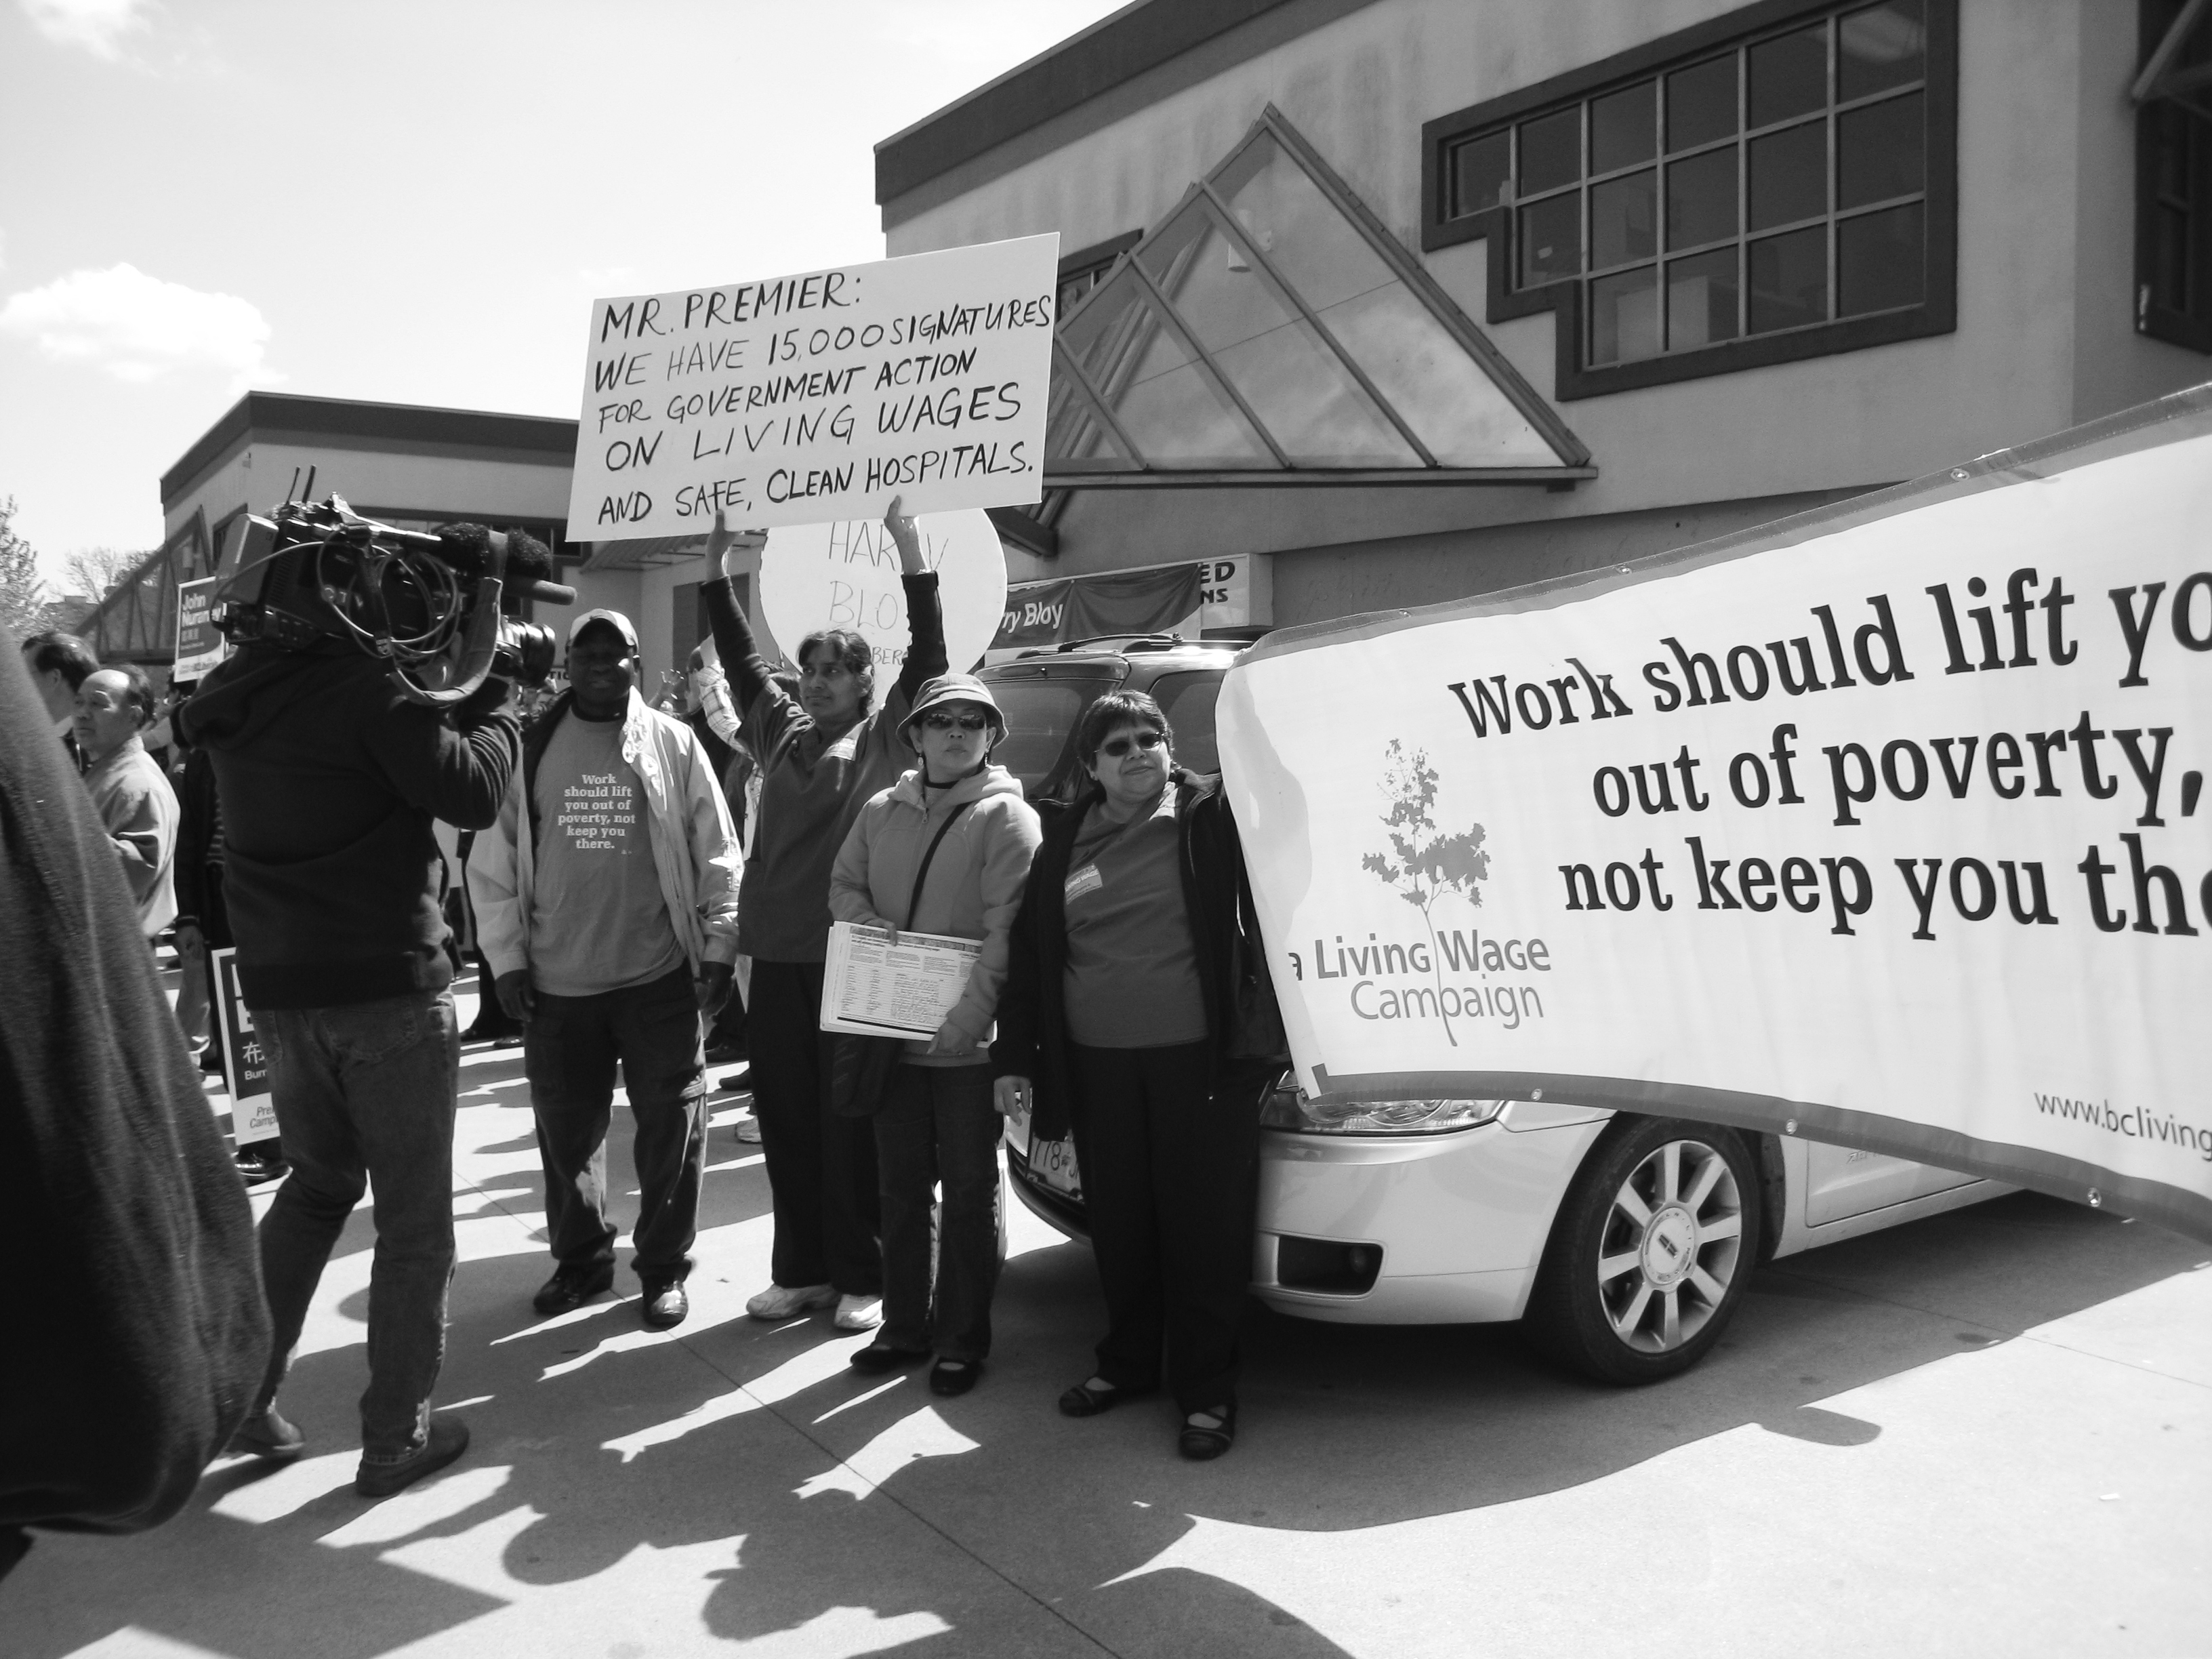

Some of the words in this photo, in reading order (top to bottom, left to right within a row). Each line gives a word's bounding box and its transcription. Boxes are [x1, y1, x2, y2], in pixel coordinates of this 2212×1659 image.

[600, 298, 674, 343] MR.
[684, 272, 861, 328] PREMIER:
[594, 352, 651, 393] WE
[667, 340, 749, 381] HAVE
[599, 398, 651, 434] FOR
[667, 367, 866, 419] GOVERNMENT
[875, 347, 977, 391] ACTION
[606, 431, 663, 472] ON
[693, 405, 855, 461] LIVING
[878, 383, 1021, 433] WAGES
[598, 492, 651, 525] AND
[676, 478, 753, 516] SAFE,
[766, 462, 855, 503] CLEAN
[866, 441, 1033, 493] HOSPITALS.
[1002, 611, 1021, 634] ry
[1023, 601, 1064, 629] Bloy
[1446, 658, 1633, 738] Work
[1643, 593, 1913, 714] should
[1926, 568, 2078, 675] lift
[564, 786, 609, 798] should
[611, 786, 632, 797] lift
[582, 773, 617, 785] Work
[1593, 744, 1710, 817] out
[1729, 724, 1805, 809] of
[1822, 711, 2203, 827] poverty,
[558, 813, 611, 826] poverty,
[613, 814, 636, 824] not
[565, 801, 588, 813] you
[592, 800, 614, 810] out
[617, 800, 632, 810] of
[566, 825, 597, 838] keep
[601, 827, 626, 838] you
[576, 838, 615, 849] there.
[1559, 847, 1673, 912] not
[1684, 836, 1873, 935] keep
[1894, 857, 2057, 940] you
[1351, 974, 1544, 1029] Campaign
